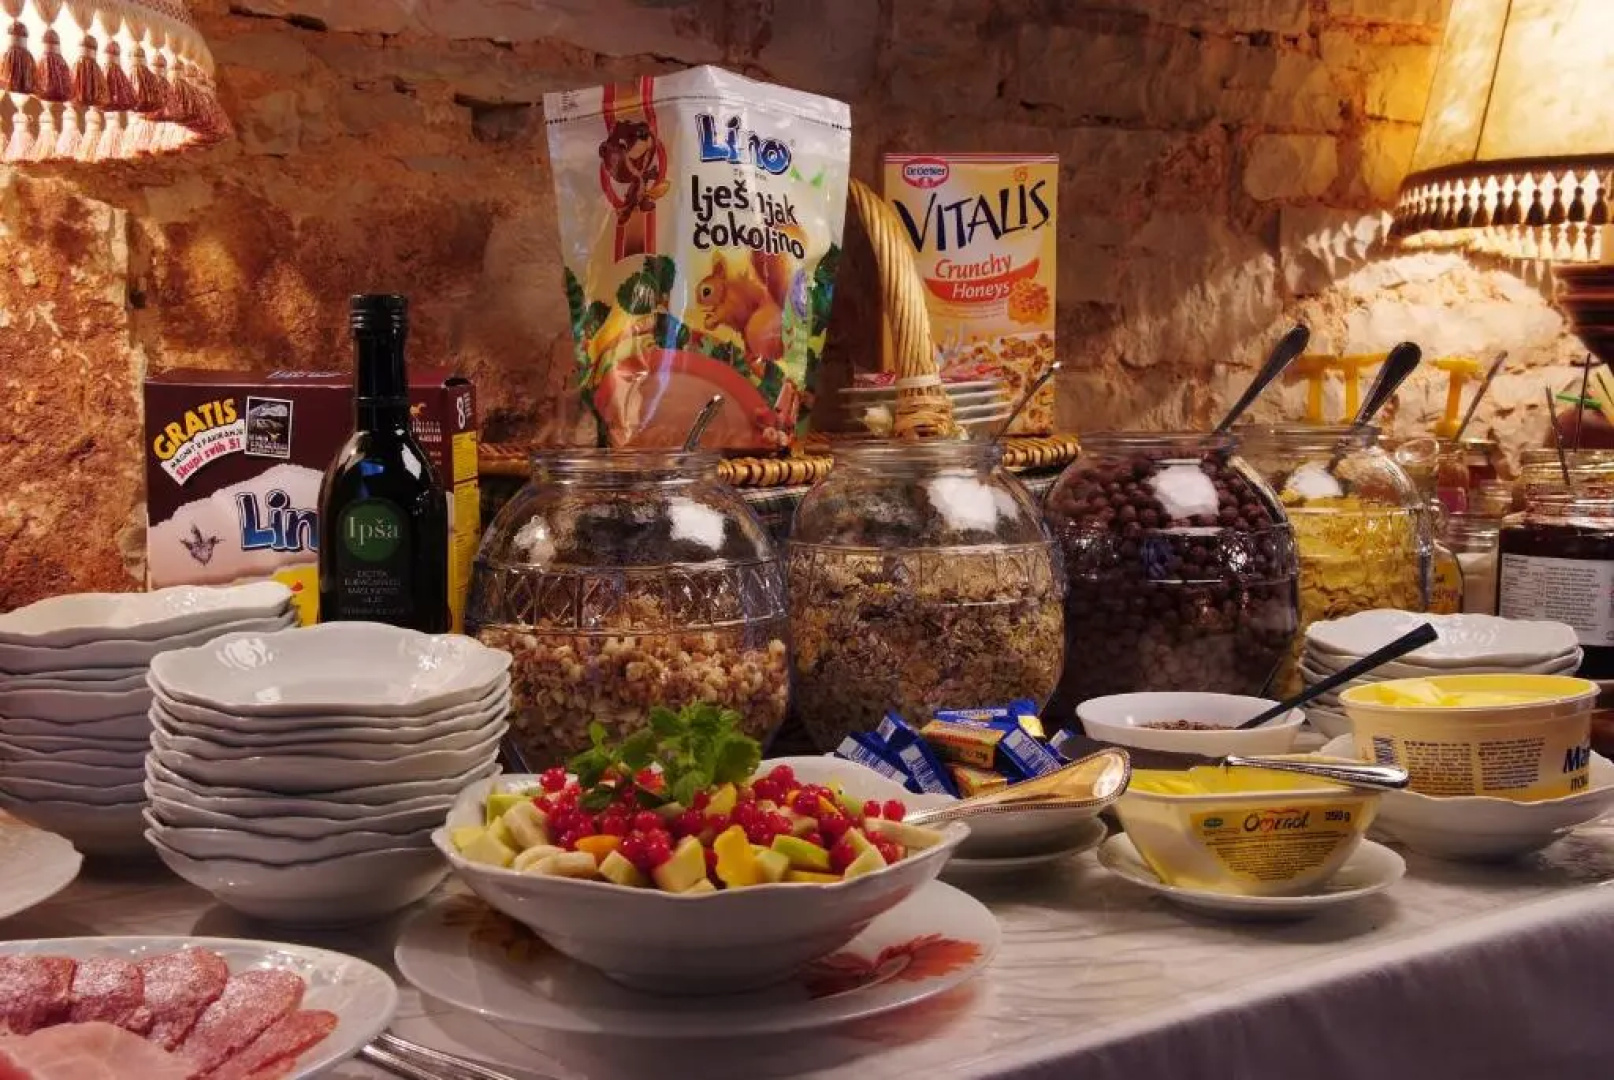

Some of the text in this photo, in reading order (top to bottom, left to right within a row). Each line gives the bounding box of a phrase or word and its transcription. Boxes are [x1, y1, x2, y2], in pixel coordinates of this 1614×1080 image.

[694, 113, 792, 175] Lino
[692, 211, 805, 259] čokolino
[892, 179, 1050, 253] VITALIS
[934, 253, 1011, 279] Crunchy
[951, 281, 1010, 301] Honeys
[153, 398, 237, 460] GRATIS
[236, 488, 320, 552] Lin
[349, 516, 400, 546] Ipša
